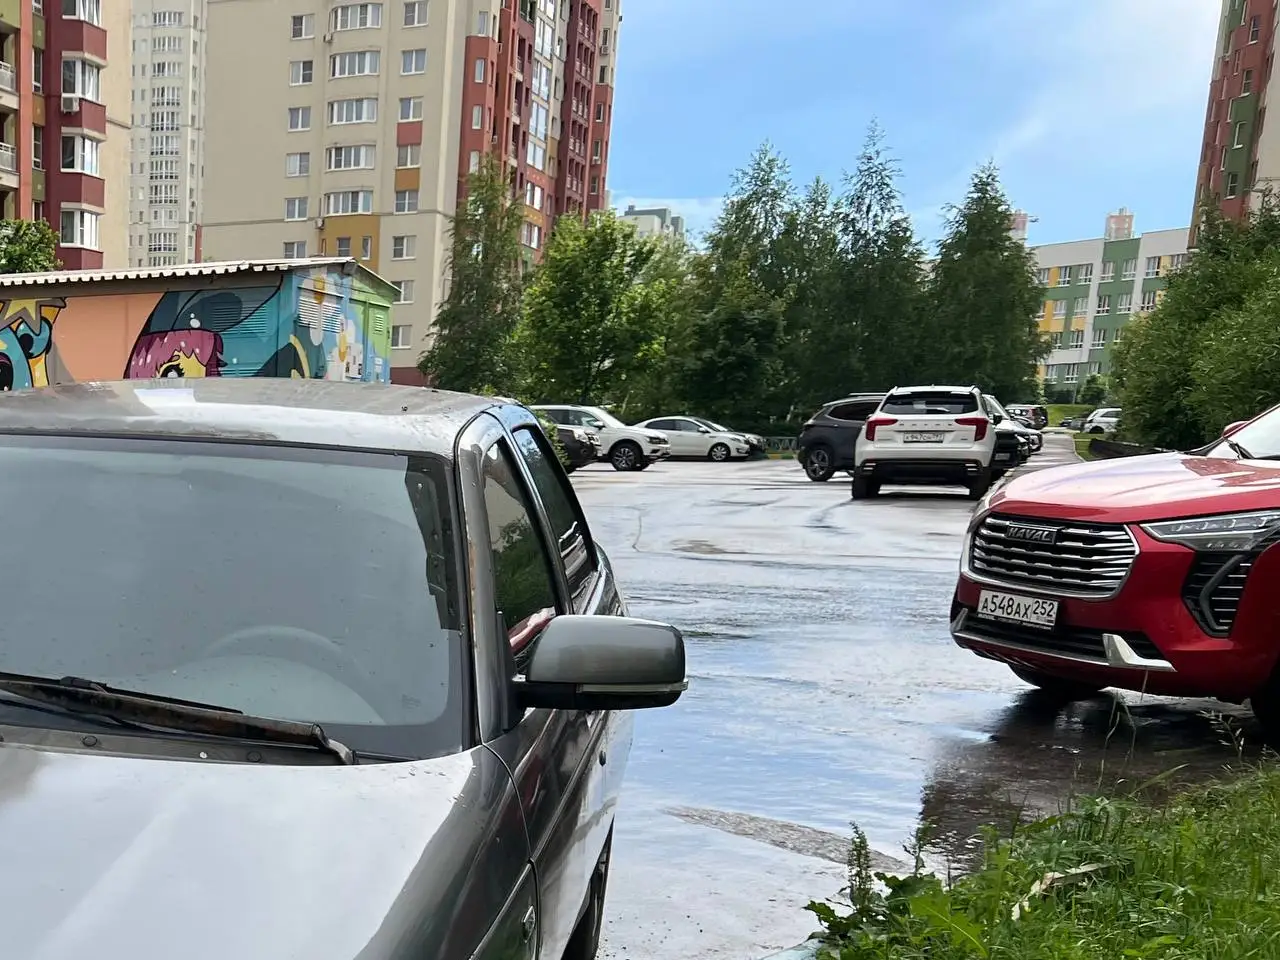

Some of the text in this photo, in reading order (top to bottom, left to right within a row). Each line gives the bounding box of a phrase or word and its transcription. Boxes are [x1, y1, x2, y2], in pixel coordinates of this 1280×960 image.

[1008, 527, 1051, 541] HAVAL
[981, 594, 1055, 619] А548АХ 252
